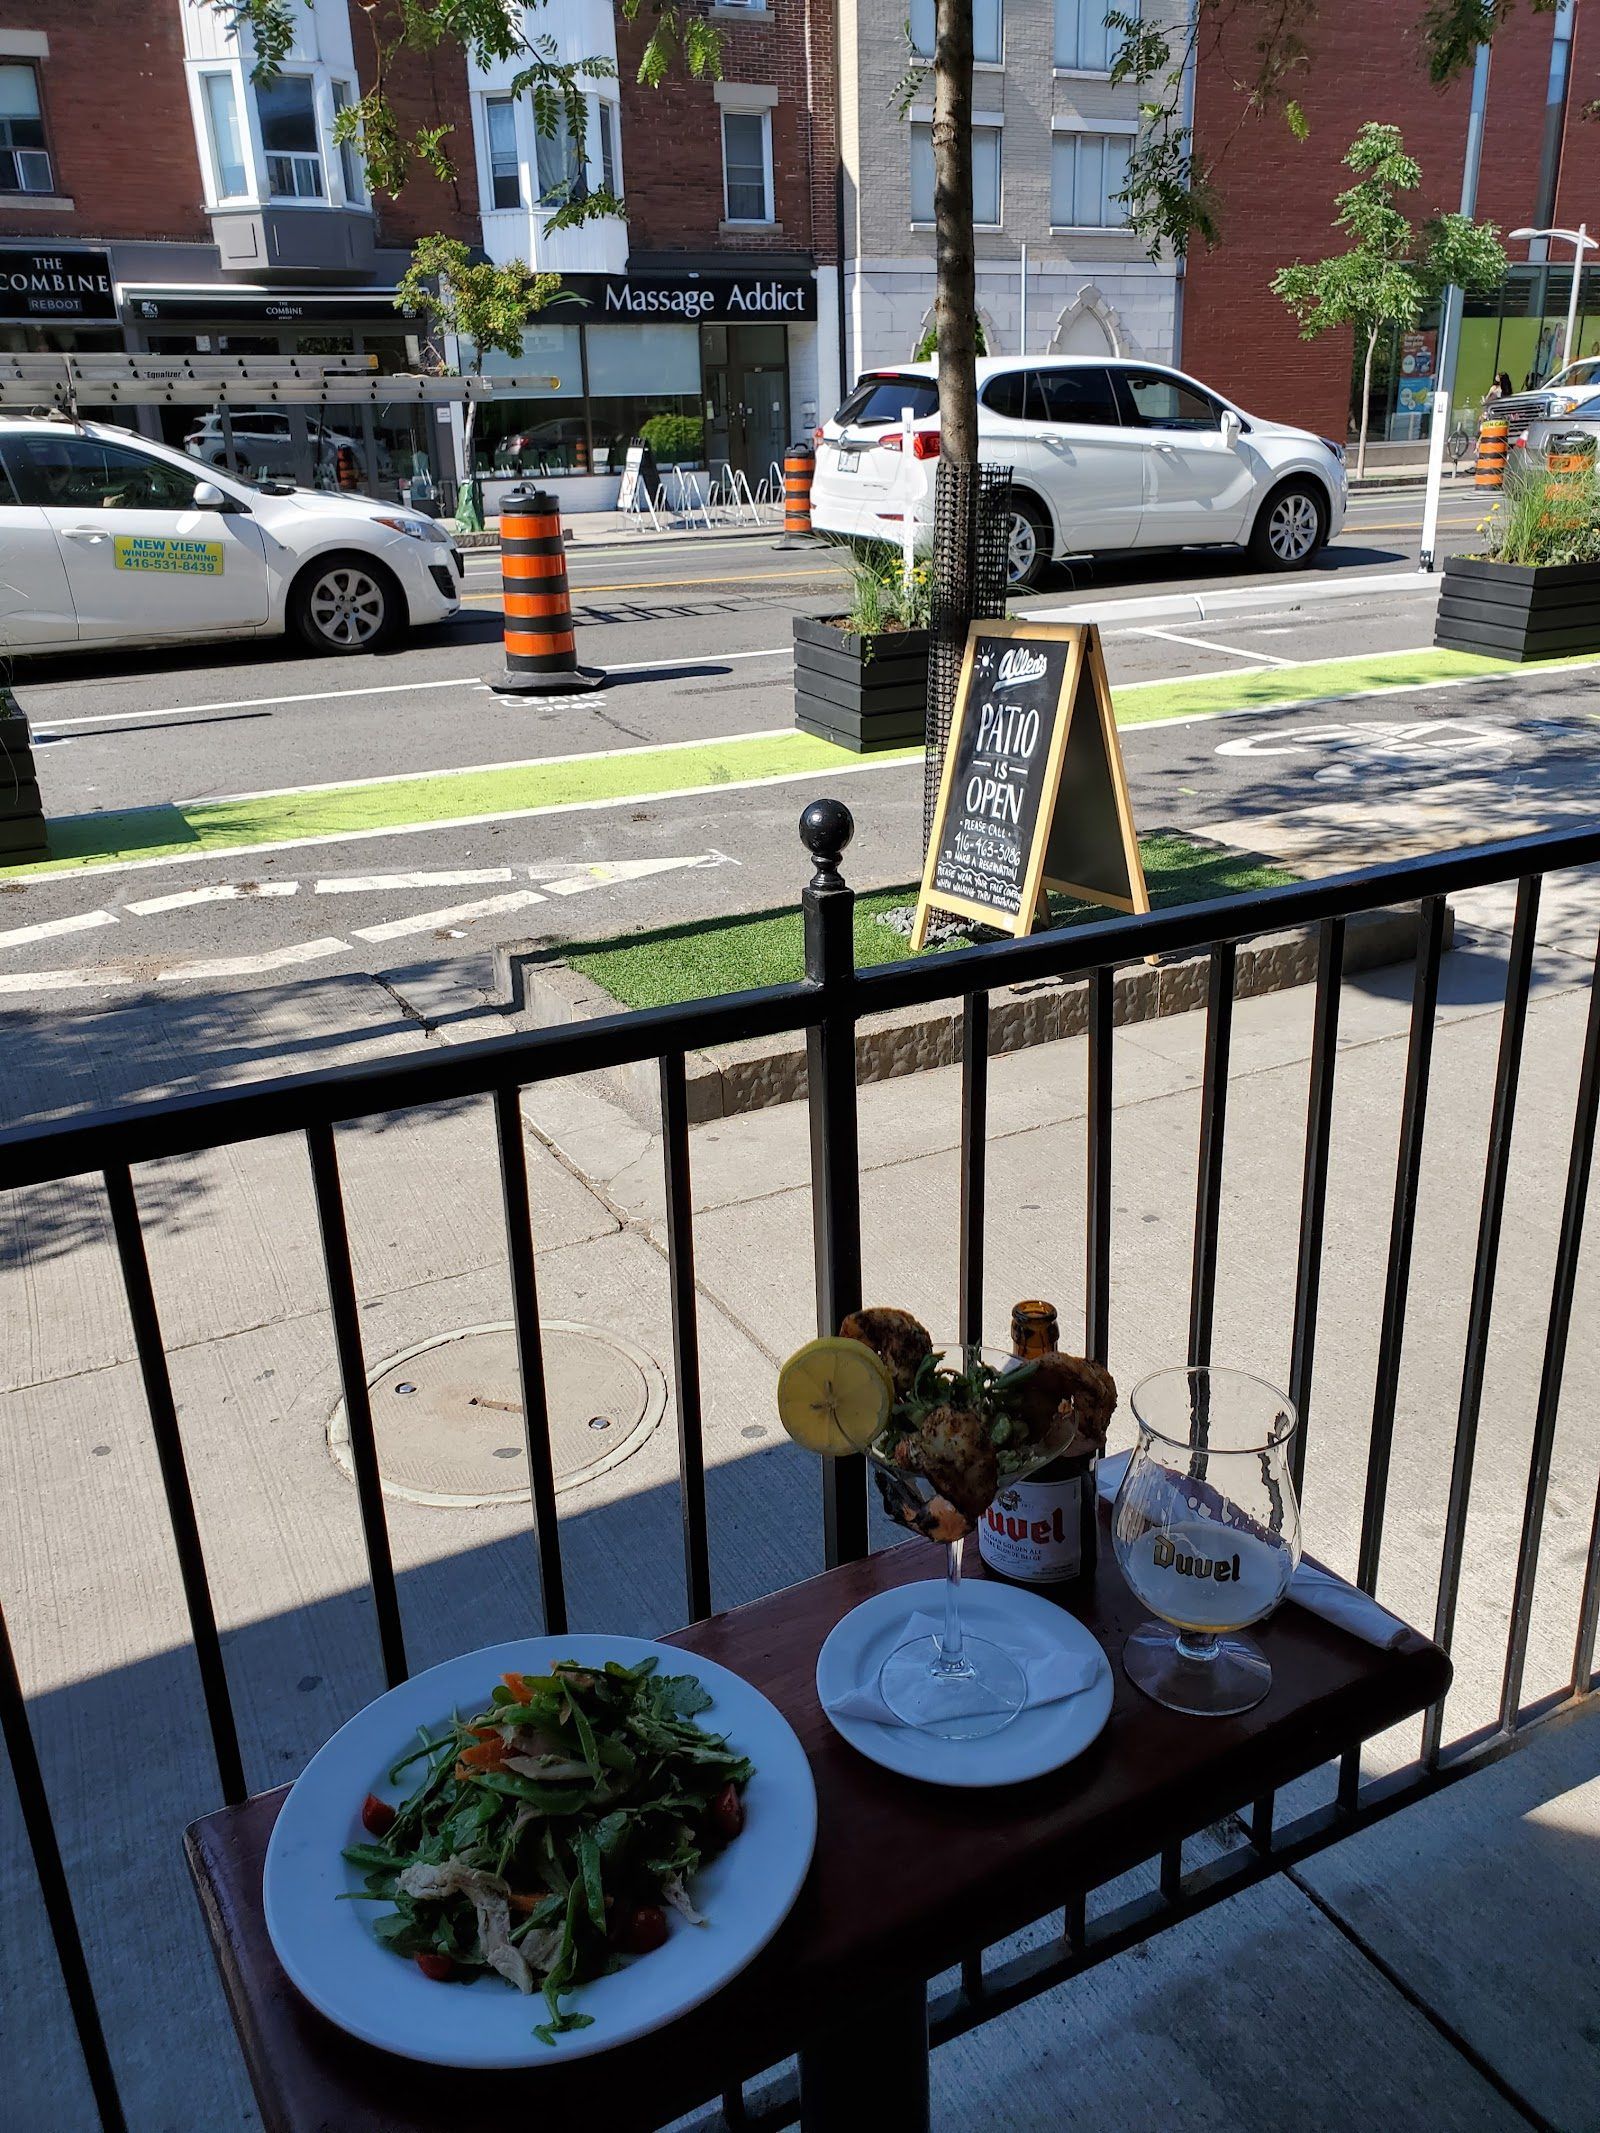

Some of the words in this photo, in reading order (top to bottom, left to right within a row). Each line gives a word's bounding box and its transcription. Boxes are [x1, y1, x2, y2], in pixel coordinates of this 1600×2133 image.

[32, 257, 63, 270] THE
[31, 300, 79, 309] REBOOT
[605, 283, 714, 318] Massage
[726, 282, 805, 311] Addict
[265, 307, 303, 315] COMBINE
[122, 549, 165, 558] WINDOW
[168, 552, 217, 562] CLEANING
[133, 539, 166, 550] NEW
[169, 542, 207, 553] VIEW
[124, 558, 214, 572] 416-531-8439
[976, 702, 1040, 758] PATIO
[994, 760, 1009, 780] IS
[966, 776, 1024, 825] OPEN
[964, 818, 986, 833] PLEASE
[988, 823, 1006, 838] CALL
[955, 831, 1021, 866] 416-463-3086
[954, 850, 971, 864] MAKE
[971, 856, 977, 868] A
[936, 878, 951, 889] WHEN
[937, 865, 956, 878] PLEASE
[957, 872, 972, 884] WEAR
[980, 1507, 1066, 1544] uvel
[1154, 1535, 1240, 1582] Duvel
